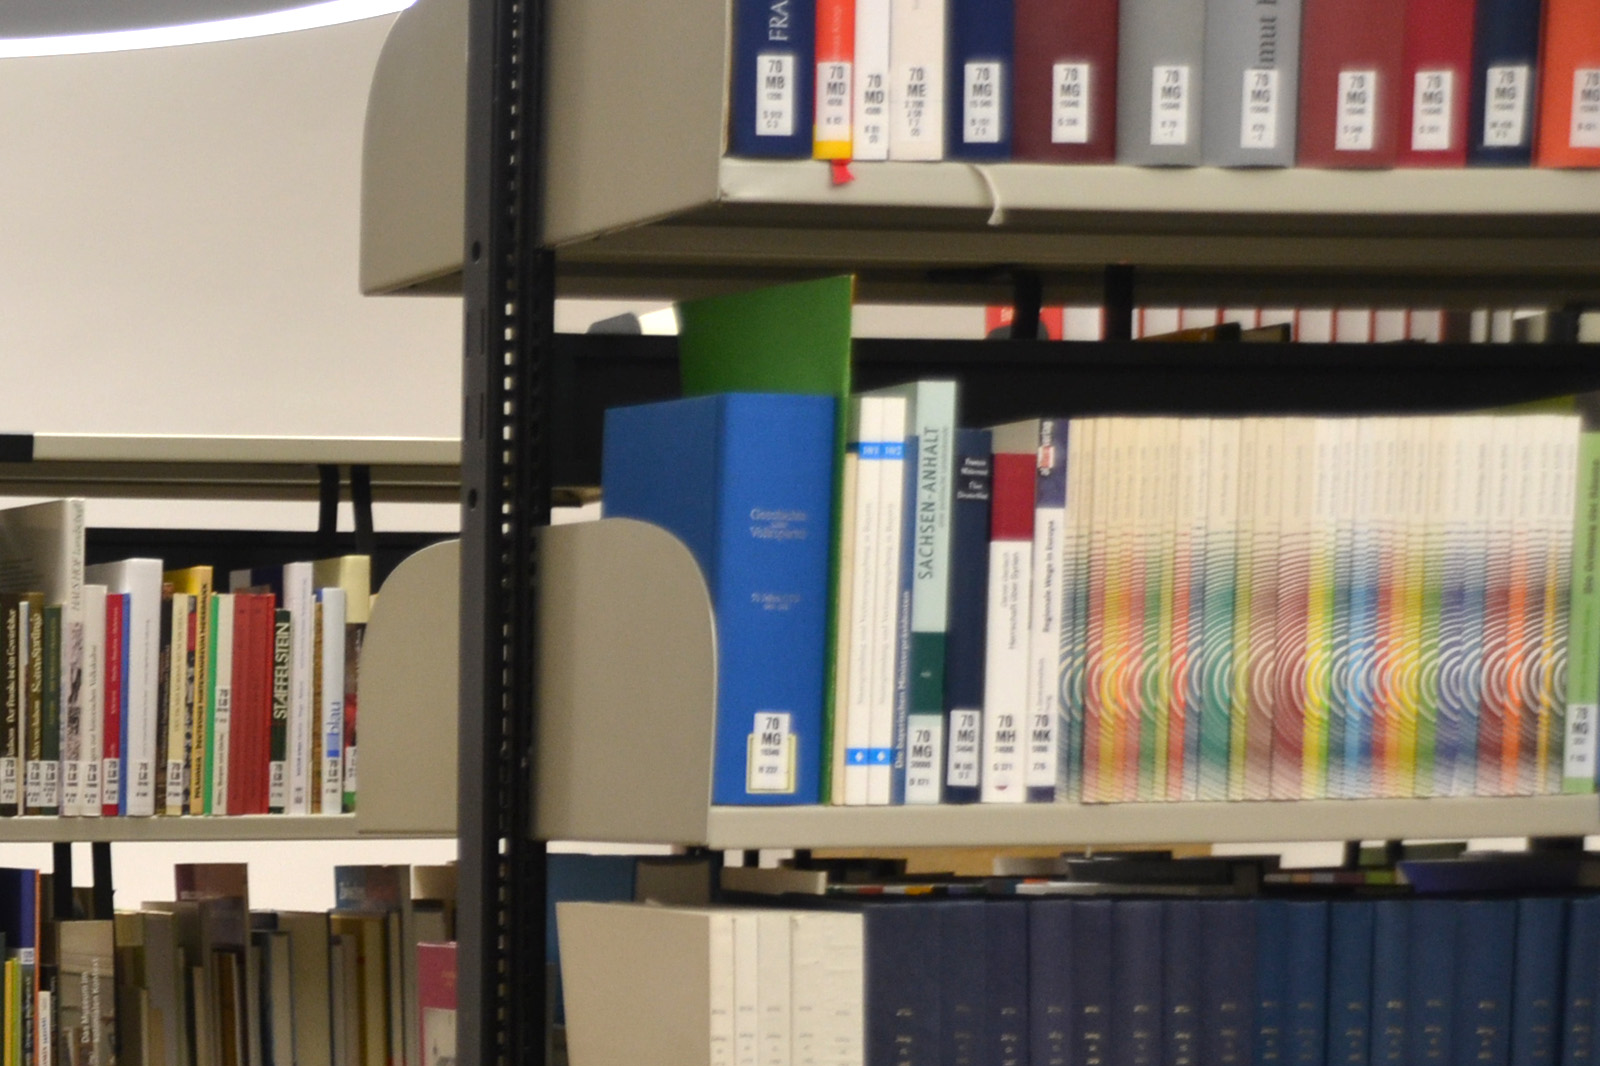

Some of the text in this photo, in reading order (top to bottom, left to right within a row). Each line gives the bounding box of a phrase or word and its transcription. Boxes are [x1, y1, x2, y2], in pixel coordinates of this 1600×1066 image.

[768, 59, 784, 74] 70
[829, 66, 845, 80] 70
[909, 67, 925, 81] 70
[975, 67, 990, 81] 70
[867, 74, 882, 88] 70
[1063, 68, 1078, 81] 70
[1164, 70, 1180, 84] 70
[1253, 73, 1268, 87] 70
[765, 75, 785, 90] MB
[826, 81, 846, 96] MD
[864, 90, 885, 105] MD
[906, 83, 926, 98] ME
[972, 83, 993, 98] MG
[1060, 84, 1081, 98] MG
[1161, 86, 1181, 101] MG
[1250, 89, 1270, 104] MG
[918, 426, 938, 580] SACHSEN-ANHALT
[273, 621, 290, 720] STAFFELSTEIN
[324, 700, 342, 736] blau
[764, 716, 780, 731] 70
[960, 714, 974, 728] 70
[997, 714, 1013, 728] 70
[1034, 714, 1049, 728] 70
[761, 731, 782, 746] MG
[915, 729, 931, 744] 70
[956, 729, 976, 743] MG
[995, 729, 1016, 744] MH
[1032, 729, 1051, 743] MK
[912, 745, 933, 759] MG
[80, 985, 90, 1024] Museum
[80, 1024, 90, 1043] Das
